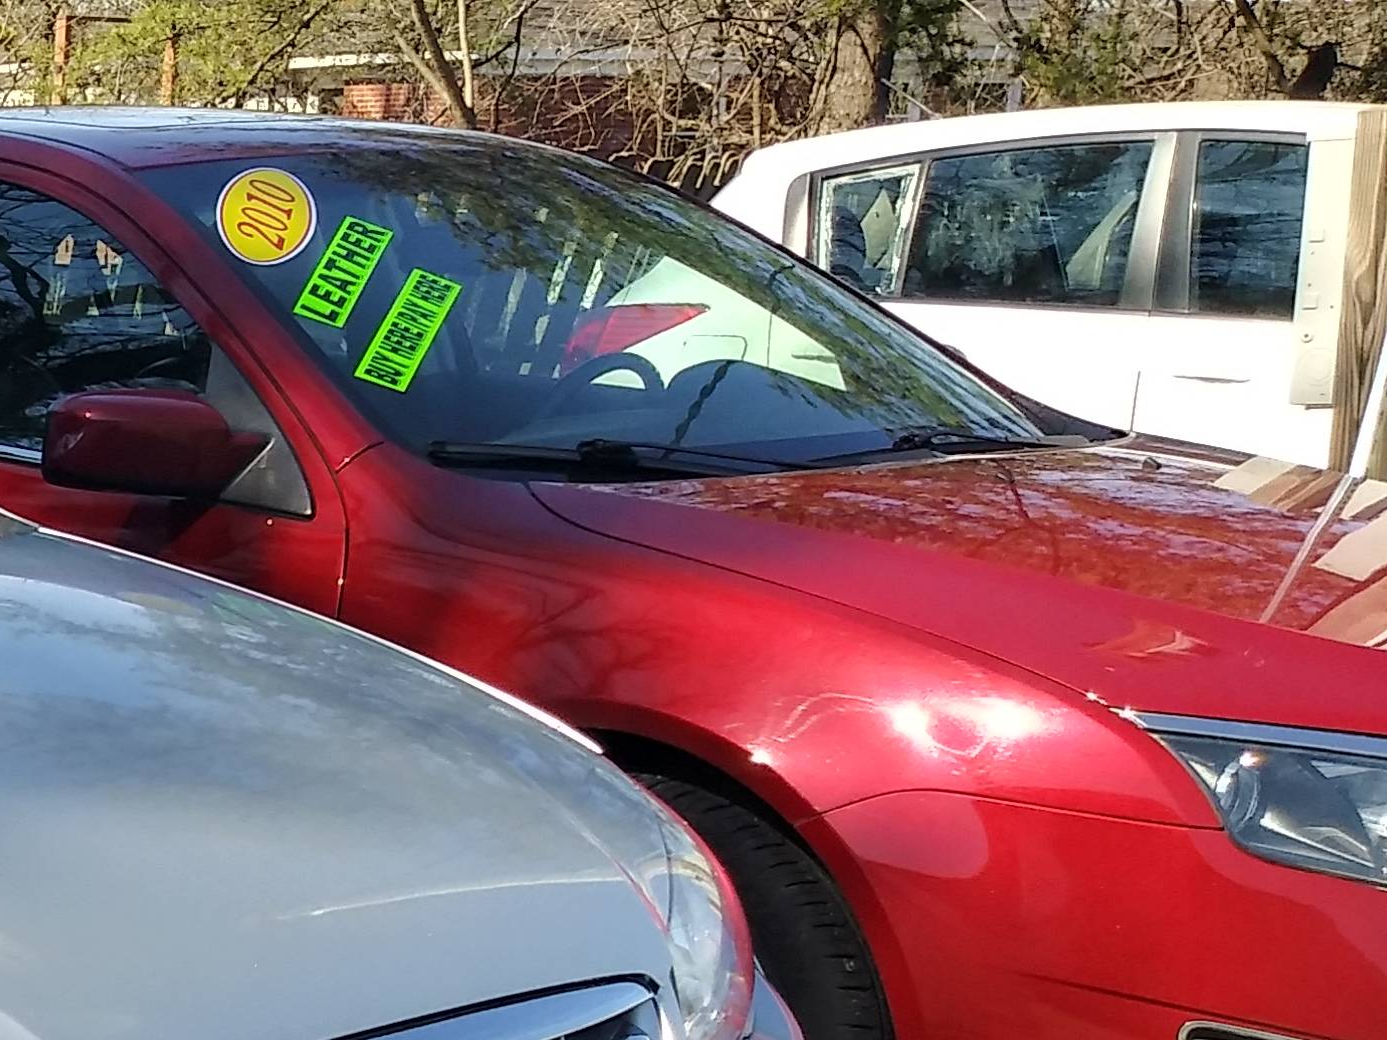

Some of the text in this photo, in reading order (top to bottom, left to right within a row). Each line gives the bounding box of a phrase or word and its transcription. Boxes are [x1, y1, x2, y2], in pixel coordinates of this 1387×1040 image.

[237, 178, 296, 251] 2010
[300, 220, 386, 323] LEATHER
[363, 350, 411, 386] BUY
[407, 273, 453, 308] HERE
